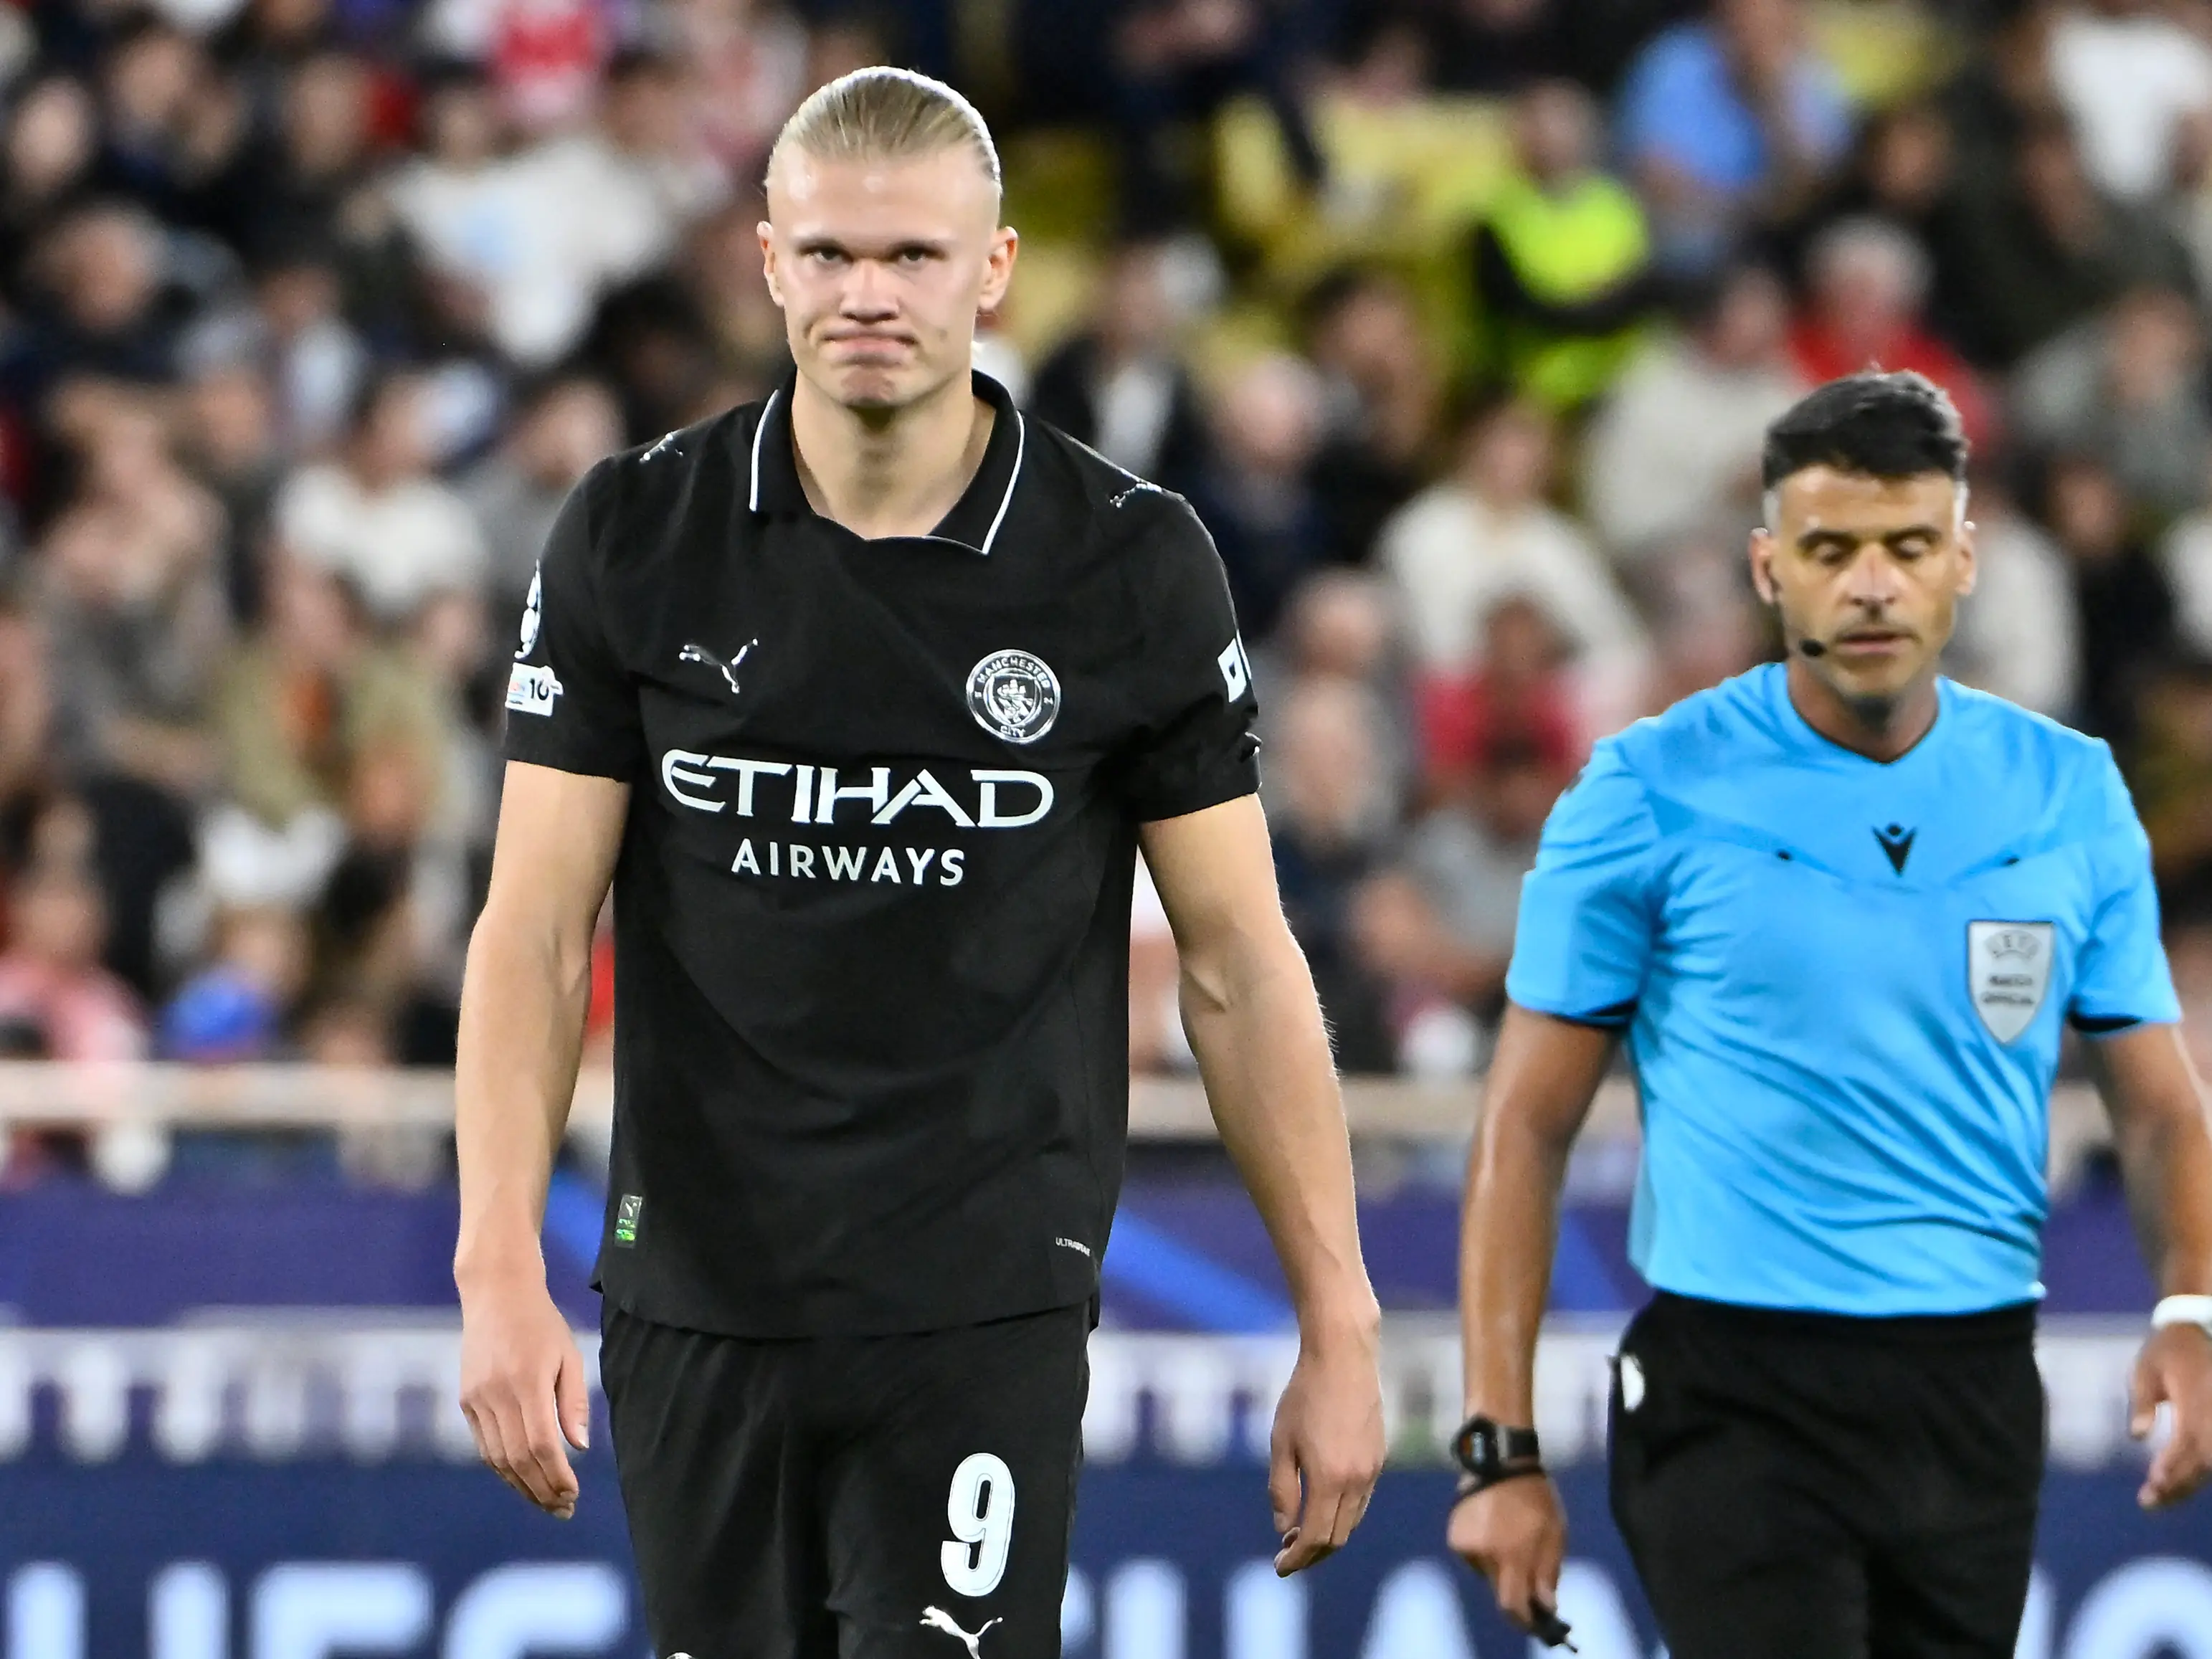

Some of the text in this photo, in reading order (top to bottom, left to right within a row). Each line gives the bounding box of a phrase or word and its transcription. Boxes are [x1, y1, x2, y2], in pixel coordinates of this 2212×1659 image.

[977, 657, 1051, 688] MANCHESTER
[1000, 726, 1025, 737] CITY
[661, 749, 1054, 827] ETIHAD
[731, 837, 965, 887] AIRWAYS
[941, 1453, 1015, 1597] 9
